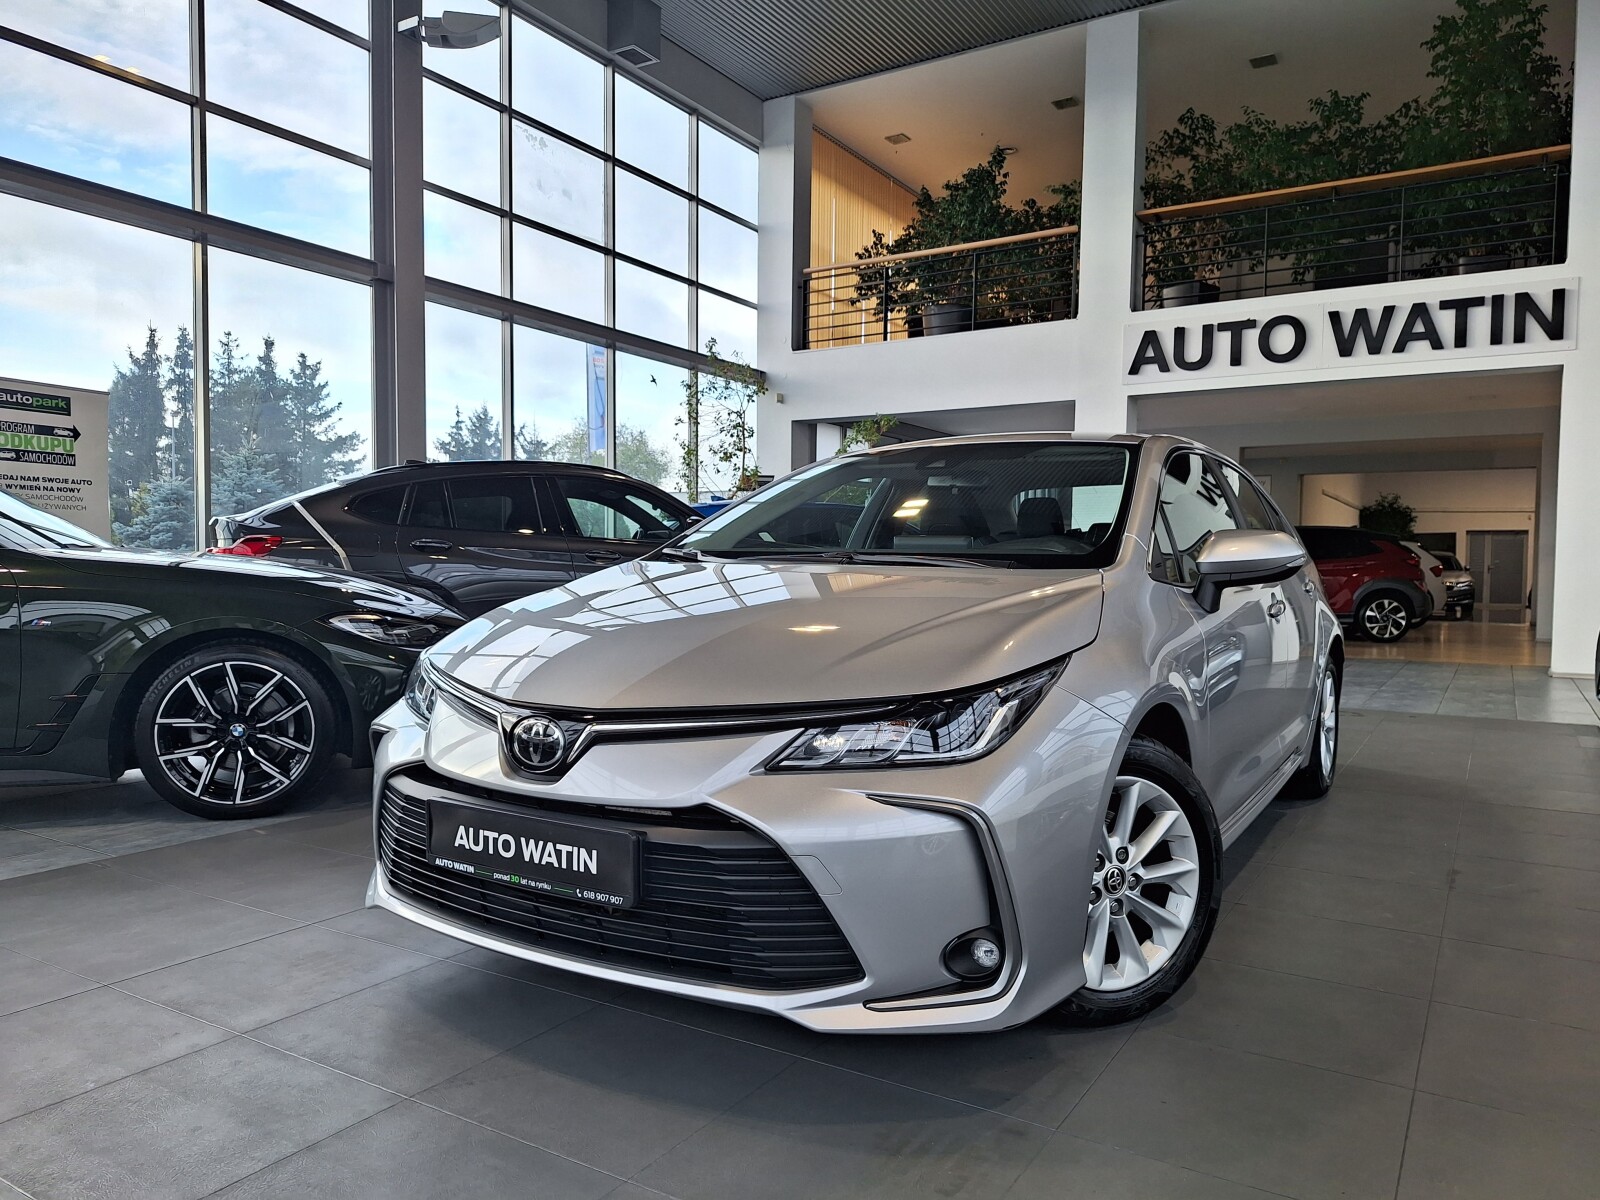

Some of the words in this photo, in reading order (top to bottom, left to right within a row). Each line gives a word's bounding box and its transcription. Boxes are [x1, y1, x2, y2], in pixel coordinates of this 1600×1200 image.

[1128, 314, 1307, 375] AUTO
[1327, 288, 1566, 357] WATIN
[0, 392, 67, 408] autopark
[0, 432, 74, 454] ODKUPU
[19, 451, 75, 466] SAMOCHODÓW
[5, 482, 41, 492] WYMIEŃ
[56, 486, 81, 494] NOWY
[41, 476, 70, 484] SWOJE
[454, 825, 516, 858] AUTO
[520, 837, 598, 875] WATIN
[434, 857, 453, 868] AUTO
[453, 861, 475, 873] WATIN
[493, 872, 511, 881] ponad
[510, 874, 520, 883] 30
[520, 876, 528, 885] lat
[528, 879, 536, 887] na
[535, 881, 552, 890] rynku
[583, 890, 595, 900] 618
[595, 892, 609, 902] 907
[609, 895, 624, 905] 907
